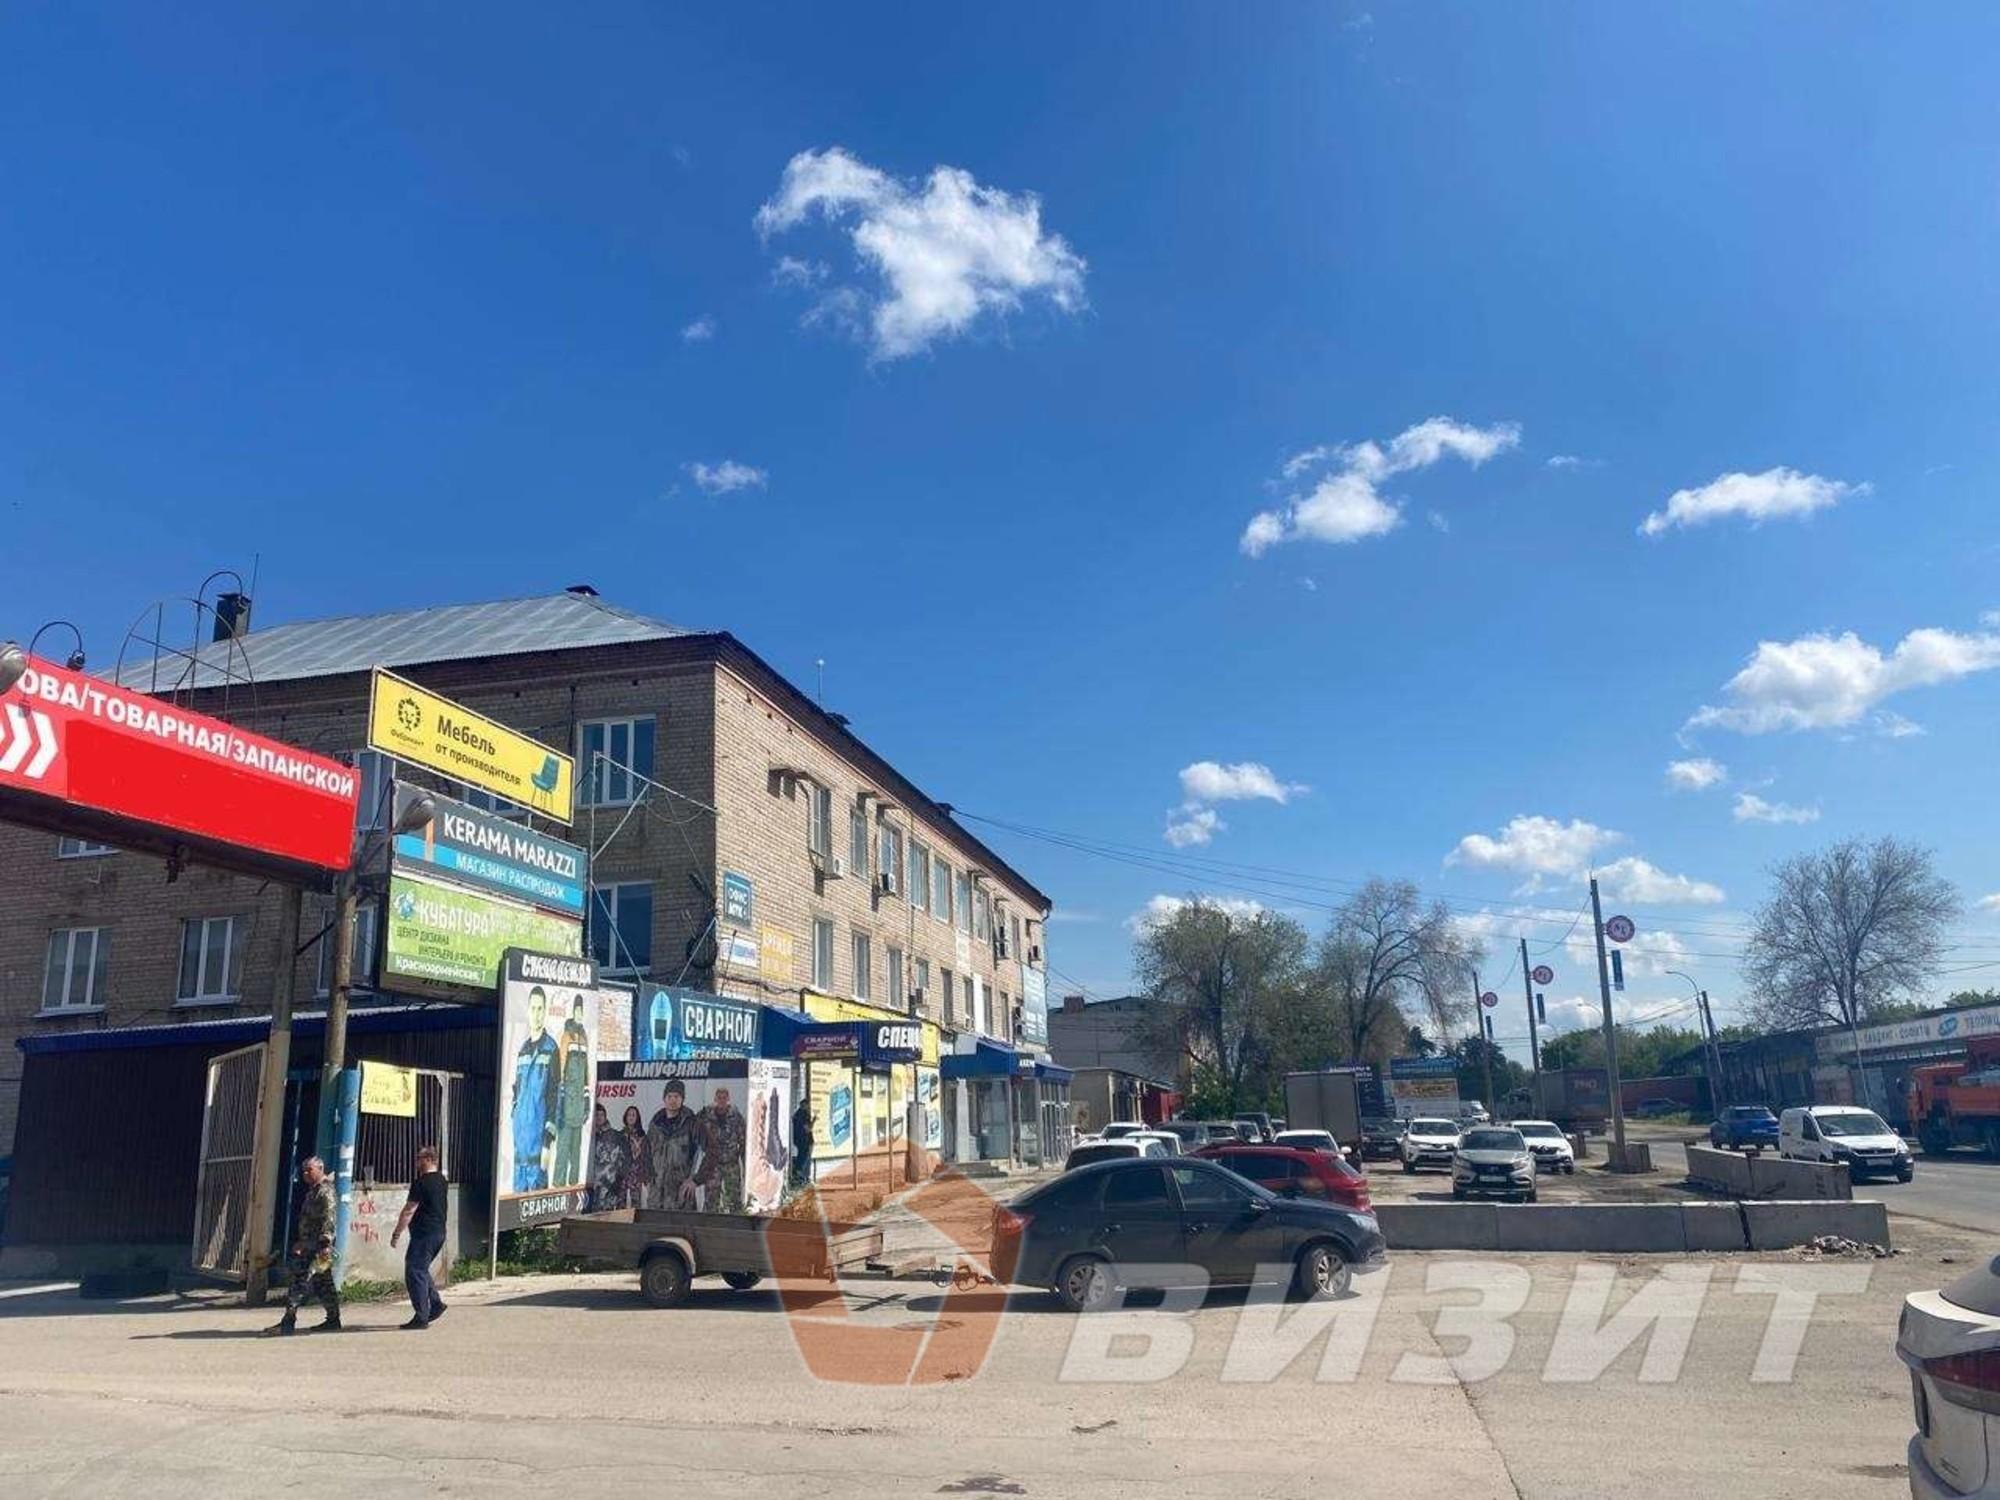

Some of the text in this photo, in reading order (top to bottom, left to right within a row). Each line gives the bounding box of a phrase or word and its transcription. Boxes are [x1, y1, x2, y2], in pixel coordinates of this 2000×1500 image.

[16, 667, 355, 798] ОВА/ТОВАРНАЯ/ЗАПАНСКОЙ
[436, 714, 496, 756] Мебель
[435, 743, 522, 786] от производителя
[443, 812, 576, 879] KERAMA MARAZZI
[455, 853, 565, 899] МАГАЗИН РАСПРОДАЖ
[419, 899, 489, 938] КУБАТУРА
[521, 954, 593, 986] СПЕЦОДЕЖДА
[685, 1005, 753, 1044] СВАРНОЙ
[877, 1025, 920, 1053] СПЕЦ
[623, 1061, 710, 1078] КАМУФЛЯЖ
